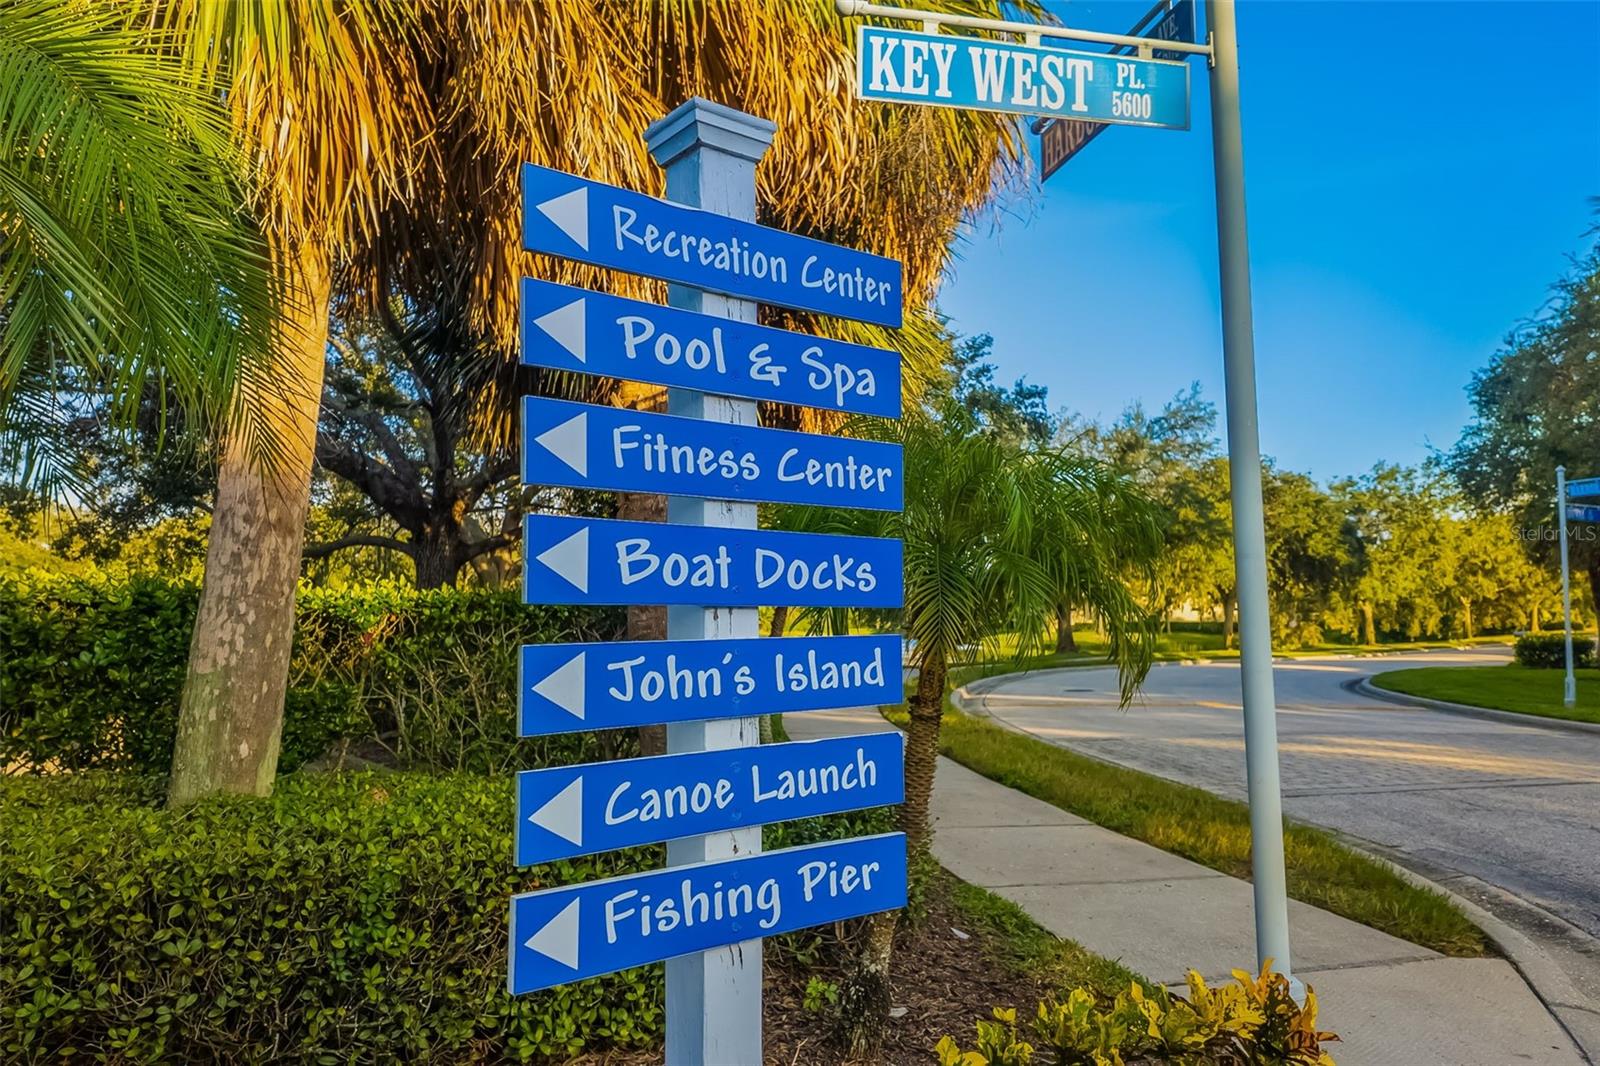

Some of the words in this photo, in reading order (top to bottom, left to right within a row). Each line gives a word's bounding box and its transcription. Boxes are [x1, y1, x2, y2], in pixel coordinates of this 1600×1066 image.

[868, 35, 957, 98] KEY
[968, 46, 1094, 112] WEST
[1112, 91, 1152, 119] 5600
[1116, 62, 1146, 90] PL.
[613, 204, 788, 283] Recreation
[801, 255, 892, 306] Center
[616, 315, 727, 374] Pool
[749, 343, 787, 386] &
[801, 345, 876, 407] Spa
[613, 425, 761, 481] Fitness
[777, 448, 893, 492] Center
[615, 538, 732, 589] Boat
[754, 548, 877, 592] Docks
[607, 652, 756, 702] John's
[775, 647, 885, 692] Island
[604, 779, 734, 826] Canoe
[751, 748, 877, 803] Launch
[604, 877, 781, 944] Fishing
[797, 860, 880, 902] Pier
